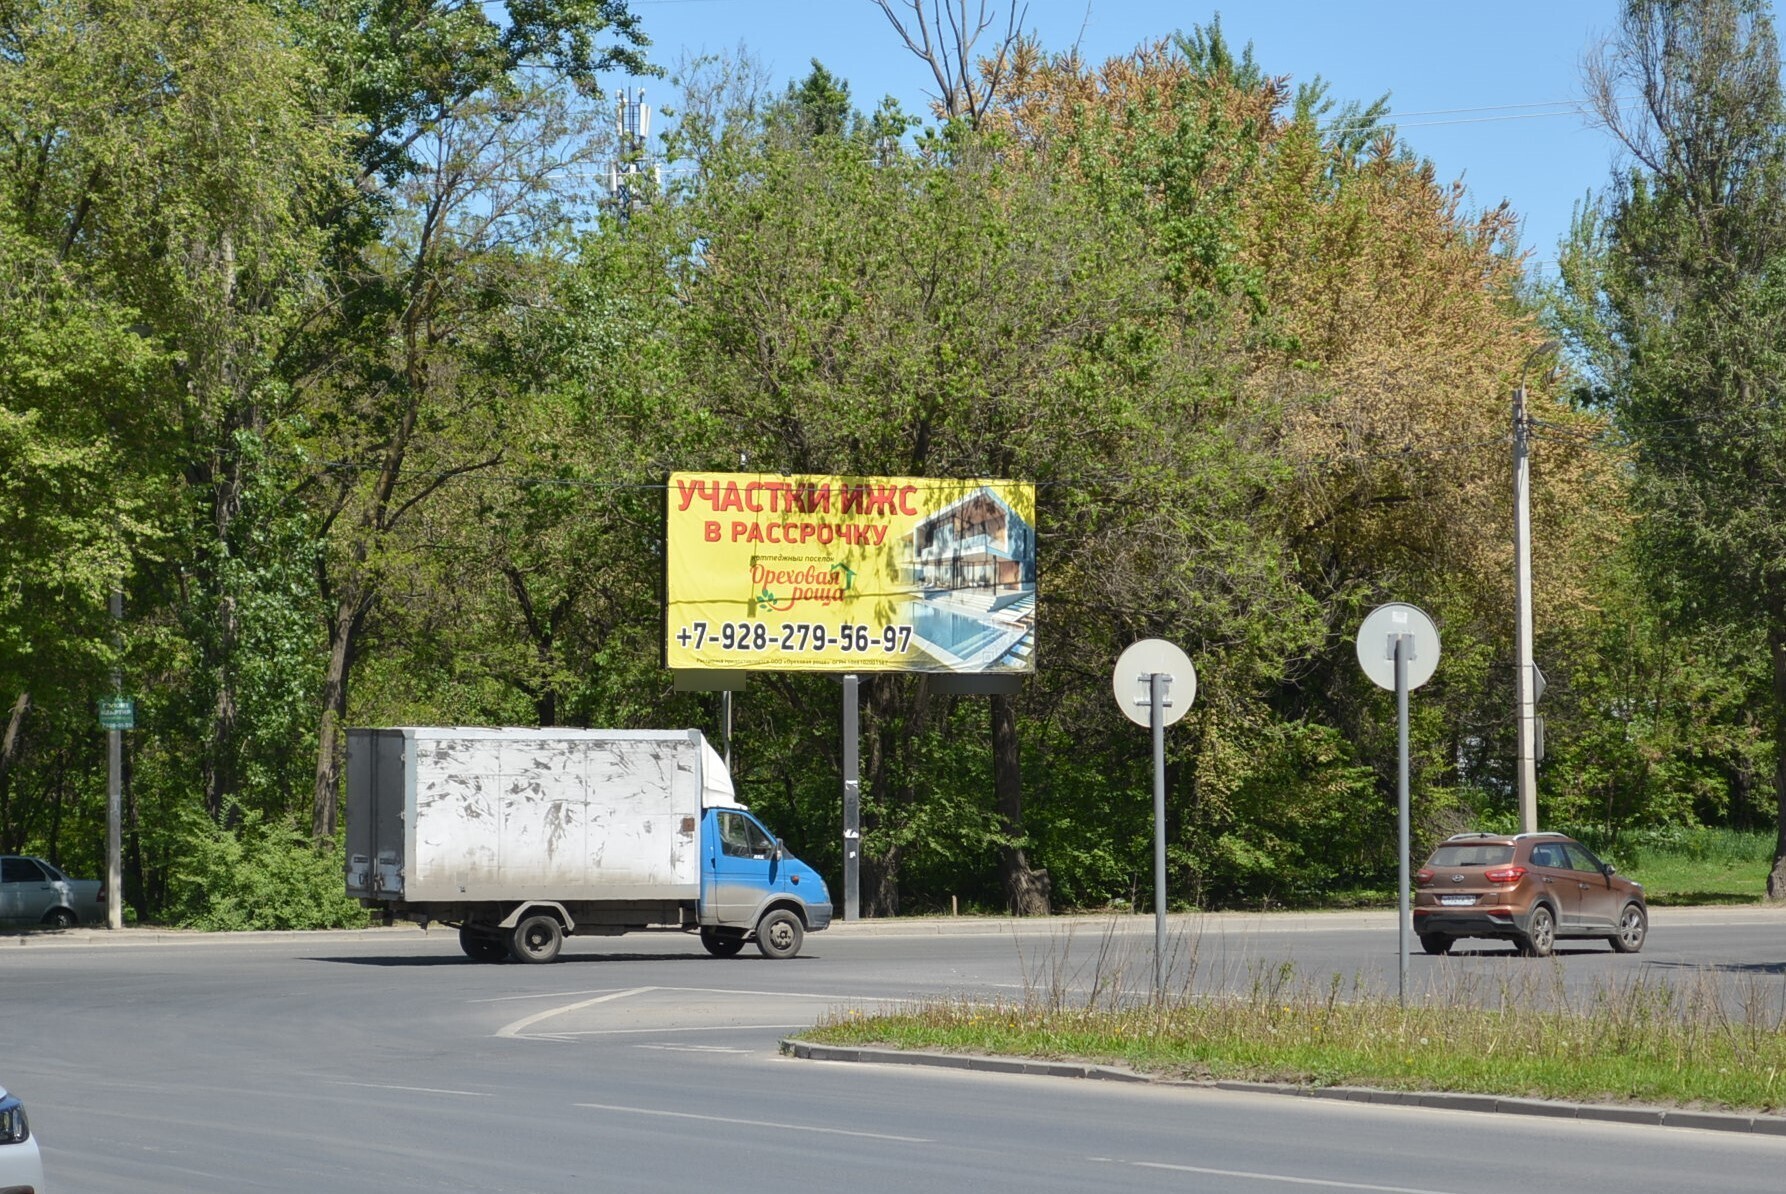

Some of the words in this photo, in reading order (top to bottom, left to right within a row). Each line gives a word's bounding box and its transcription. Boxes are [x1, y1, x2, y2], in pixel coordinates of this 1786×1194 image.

[677, 479, 830, 514] УЧАСТКИ
[840, 483, 918, 516] ИЖС
[704, 520, 722, 543] В
[731, 521, 888, 546] РАССРОЧКУ
[750, 564, 840, 589] Ореховая
[782, 586, 845, 610] роща
[677, 622, 912, 652] +7-928-279-56-97
